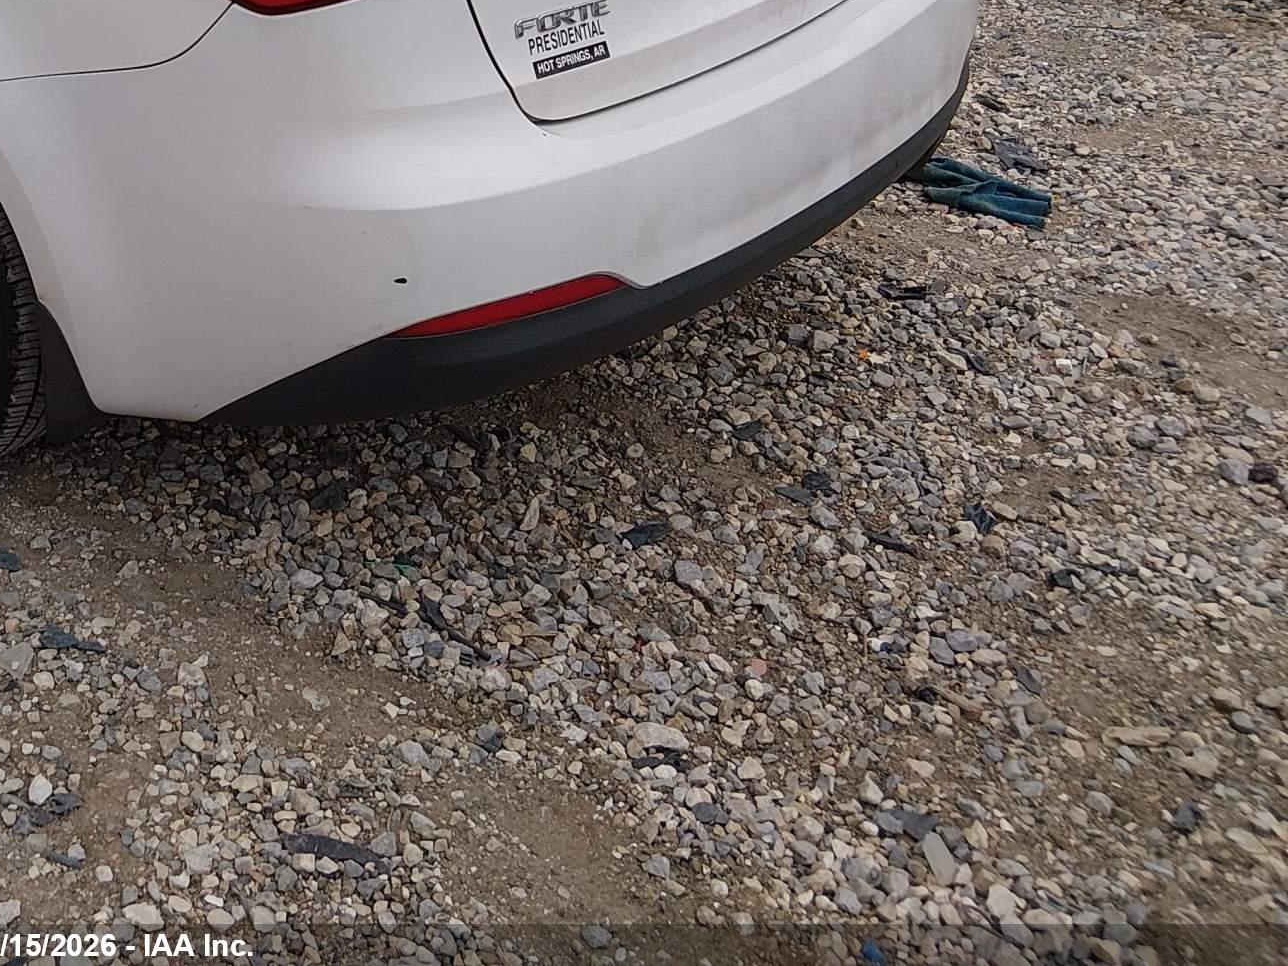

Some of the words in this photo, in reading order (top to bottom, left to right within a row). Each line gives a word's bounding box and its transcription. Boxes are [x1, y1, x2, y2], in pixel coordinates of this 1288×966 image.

[527, 19, 605, 56] PRESIDENTIAL
[536, 59, 555, 75] HOT
[555, 48, 594, 69] SPRINGS,
[592, 43, 606, 58] AR
